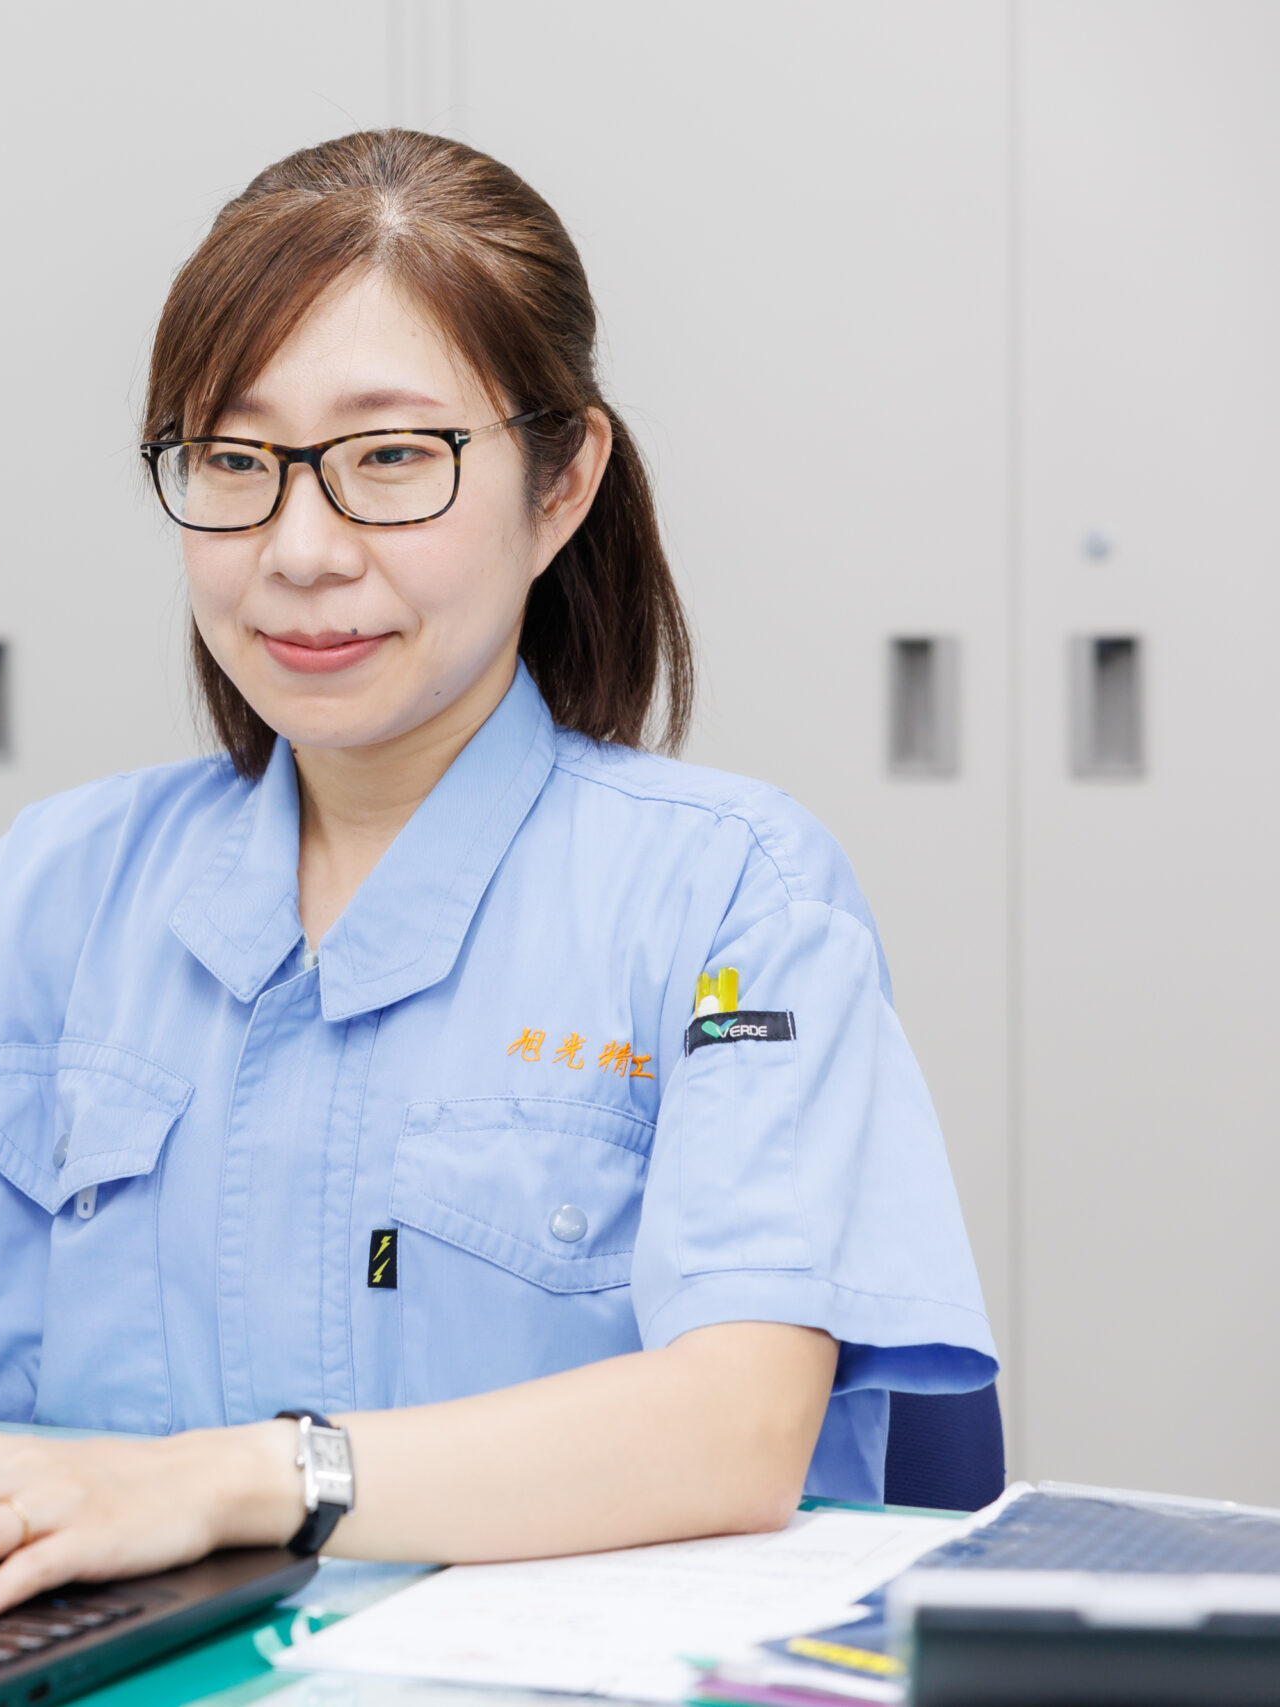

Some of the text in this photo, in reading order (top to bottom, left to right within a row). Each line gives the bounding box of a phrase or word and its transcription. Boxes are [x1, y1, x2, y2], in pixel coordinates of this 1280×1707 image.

[715, 1024, 768, 1039] VERDE
[506, 1026, 655, 1080] 旭光精工
